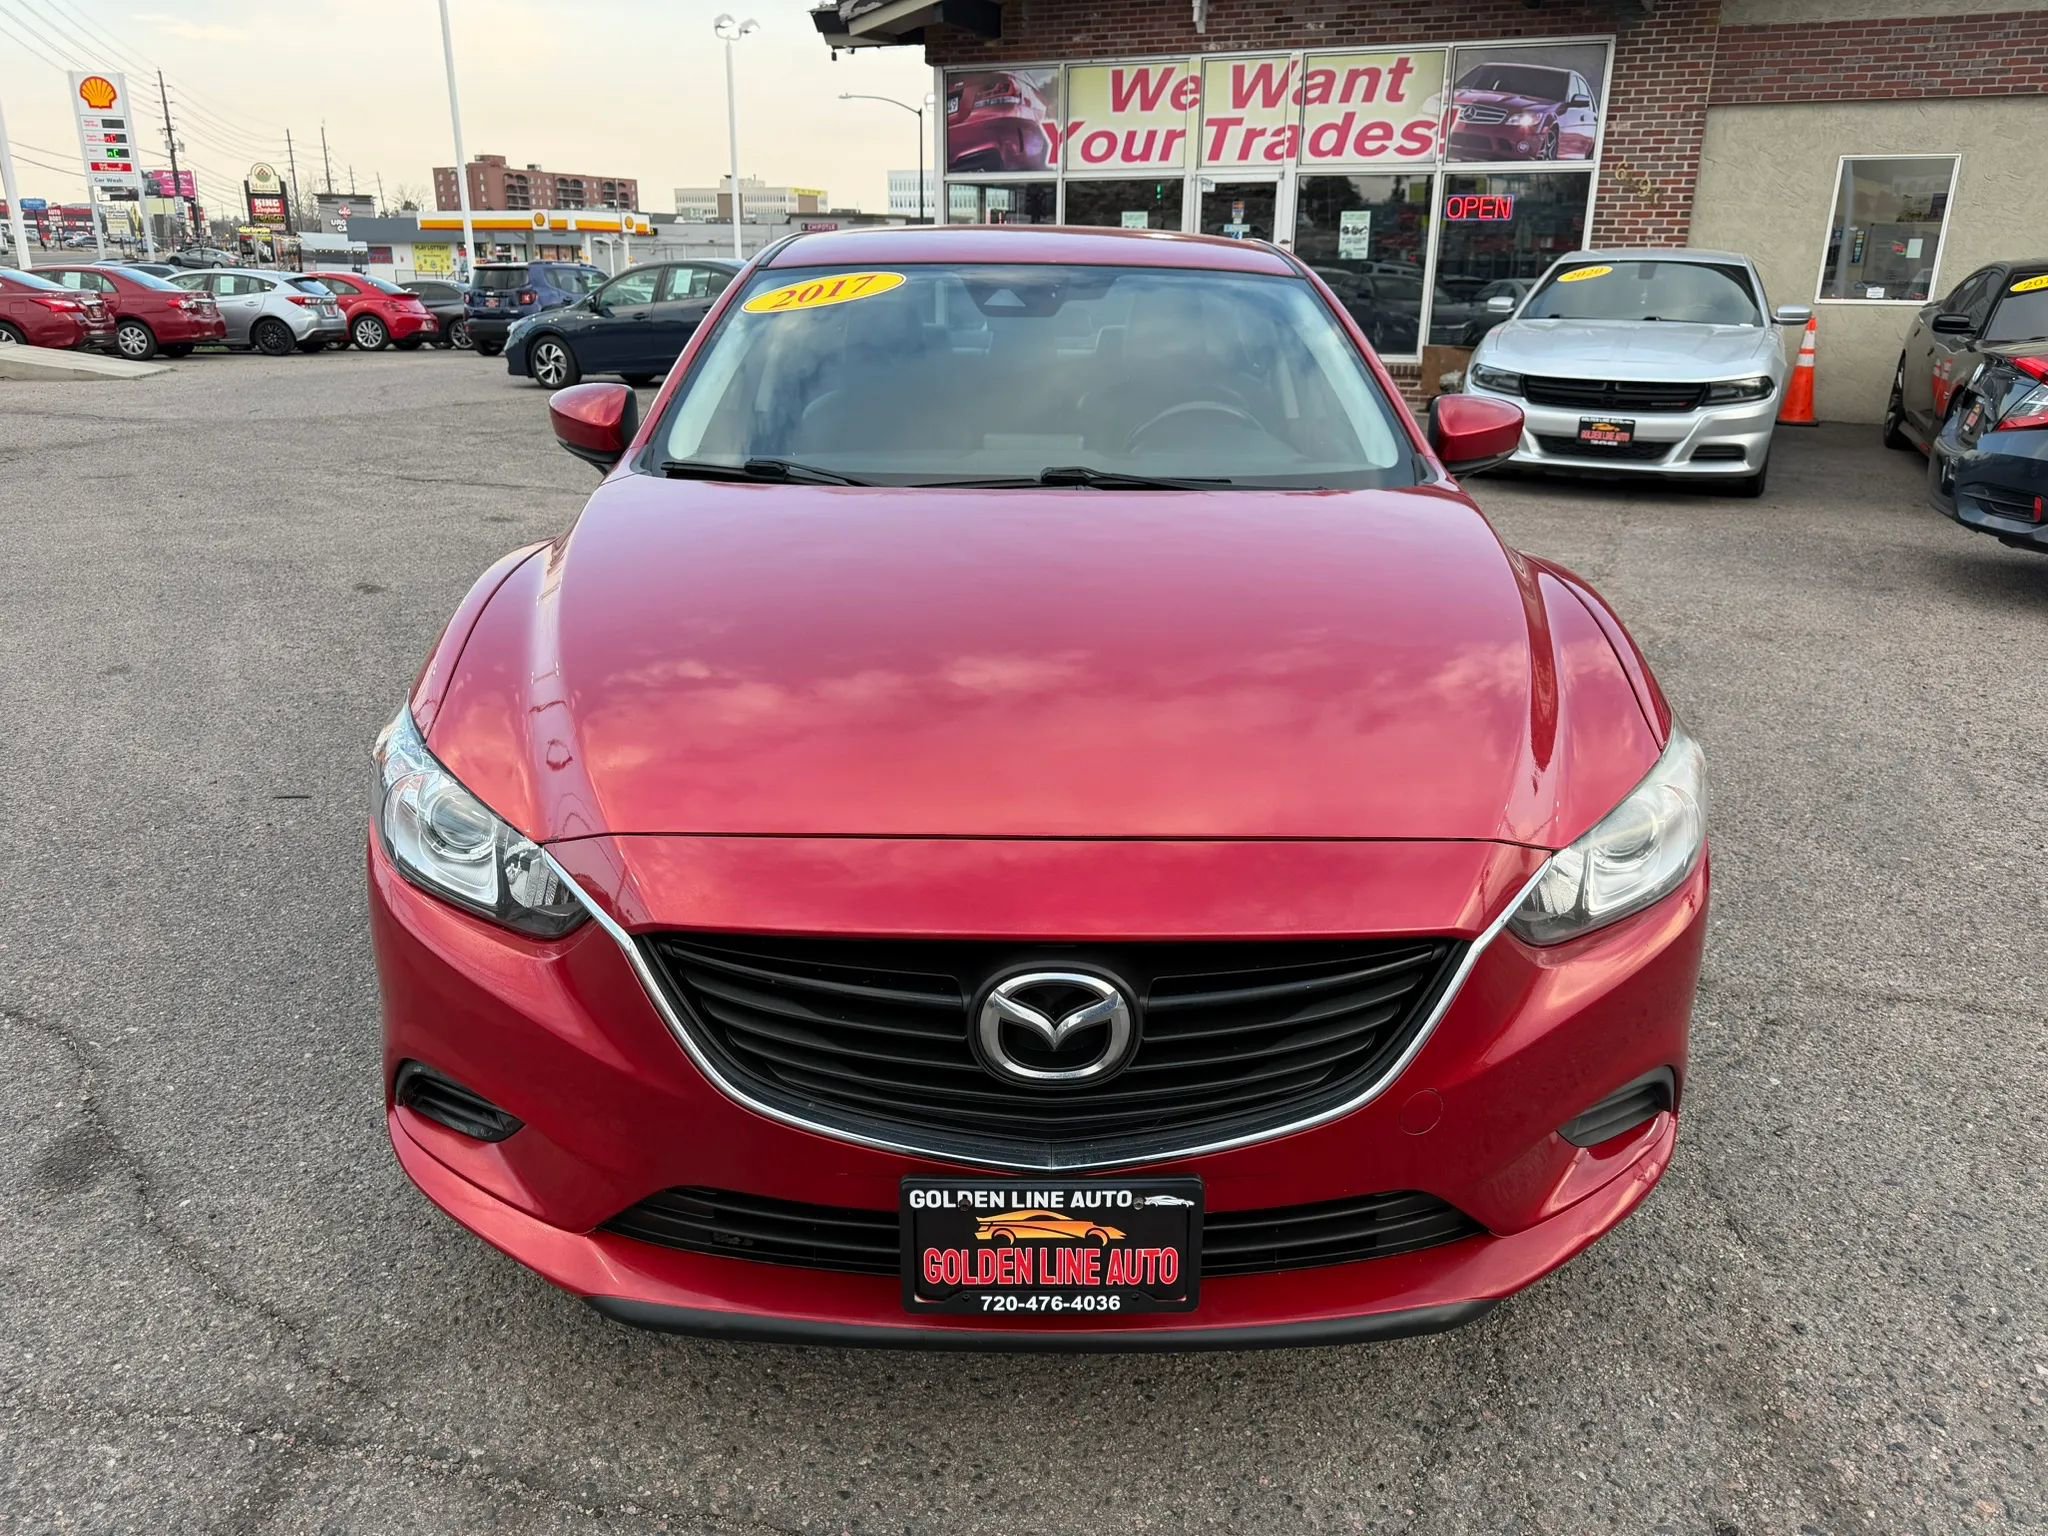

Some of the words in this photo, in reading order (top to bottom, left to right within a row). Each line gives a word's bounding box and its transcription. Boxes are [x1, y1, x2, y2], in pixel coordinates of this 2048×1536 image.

[1111, 66, 1200, 113] We
[1231, 56, 1415, 110] Want
[1041, 120, 1187, 166] Your
[1204, 106, 1460, 163] Trades!
[1447, 197, 1511, 219] OPEN
[768, 275, 878, 310] 2017
[909, 1189, 1005, 1209] GOLDEN
[1011, 1190, 1064, 1208] LINE
[1070, 1189, 1132, 1208] AUTO
[923, 1247, 1033, 1285] GOLDEN
[1039, 1247, 1100, 1285] LINE
[1106, 1246, 1179, 1285] AUTO
[981, 1295, 1121, 1311] 720-476-4036
